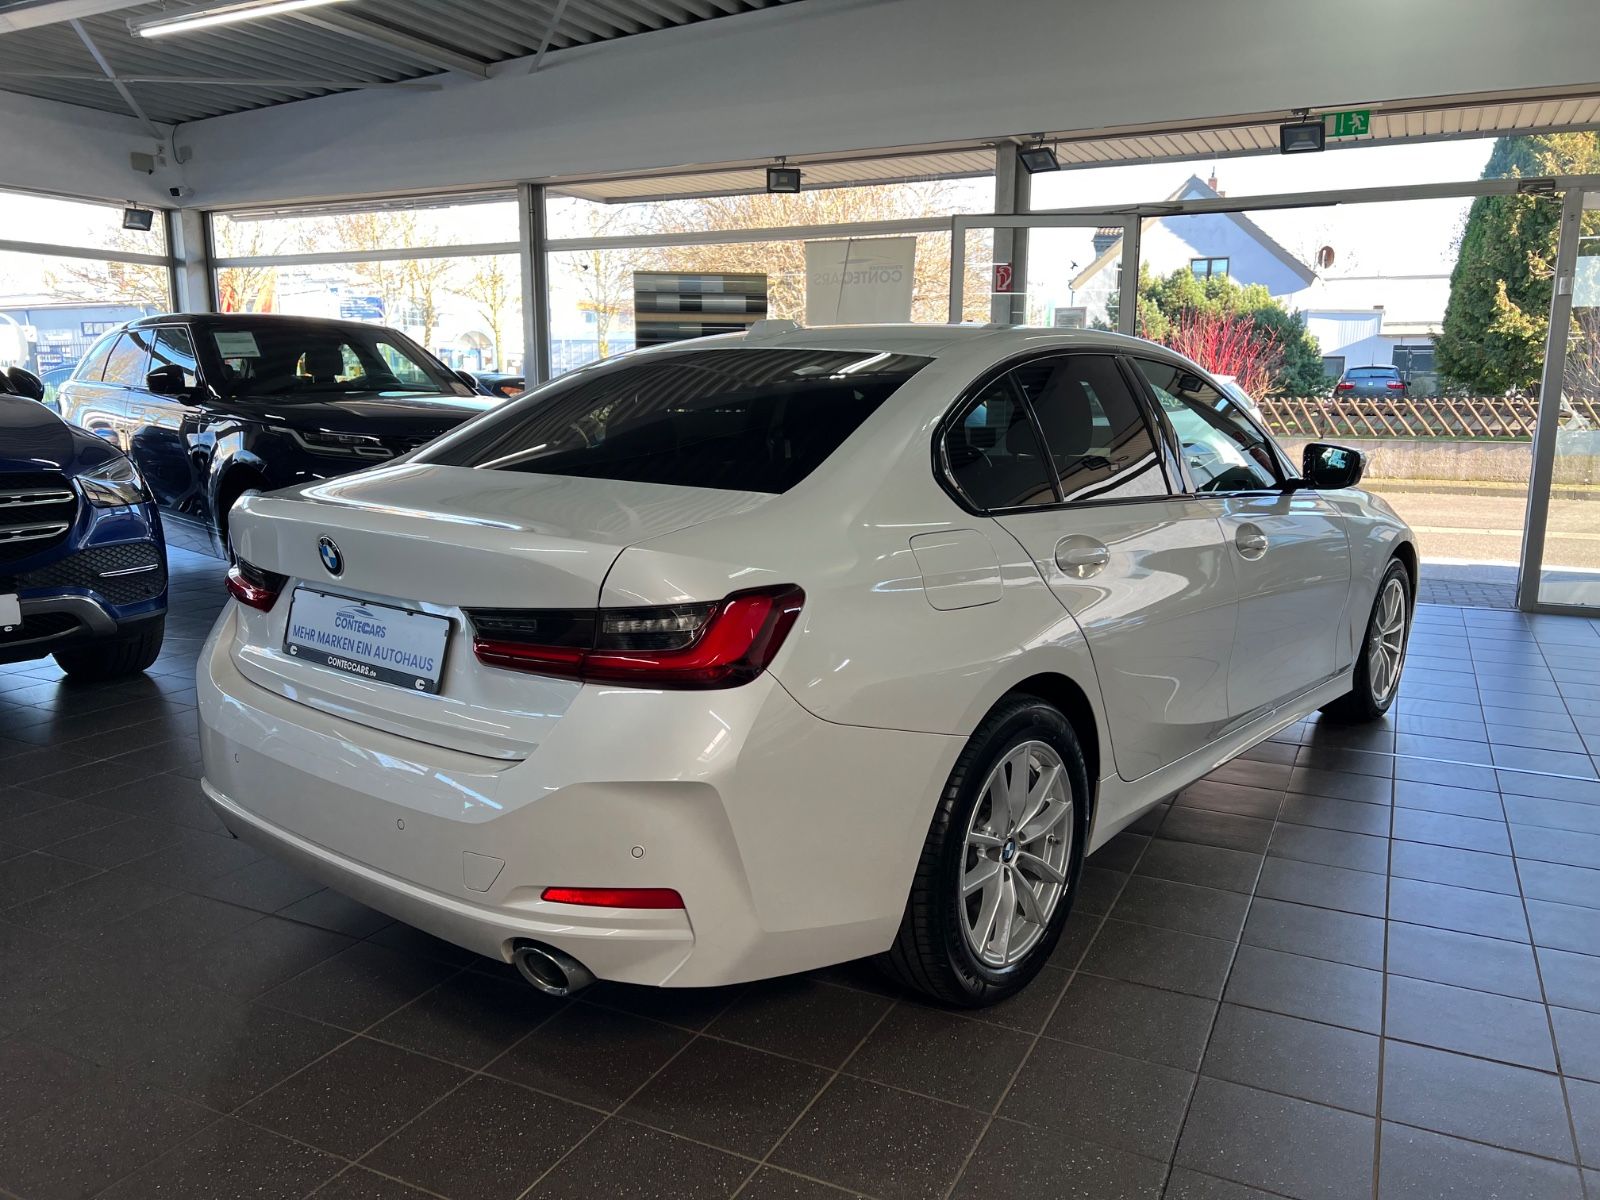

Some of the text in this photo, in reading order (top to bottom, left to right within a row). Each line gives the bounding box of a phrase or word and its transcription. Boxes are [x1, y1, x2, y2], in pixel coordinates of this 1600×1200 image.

[292, 624, 434, 672] MEHR MARKEN EIN AUTOHAUS
[327, 656, 376, 677] CONTECCARS.de
